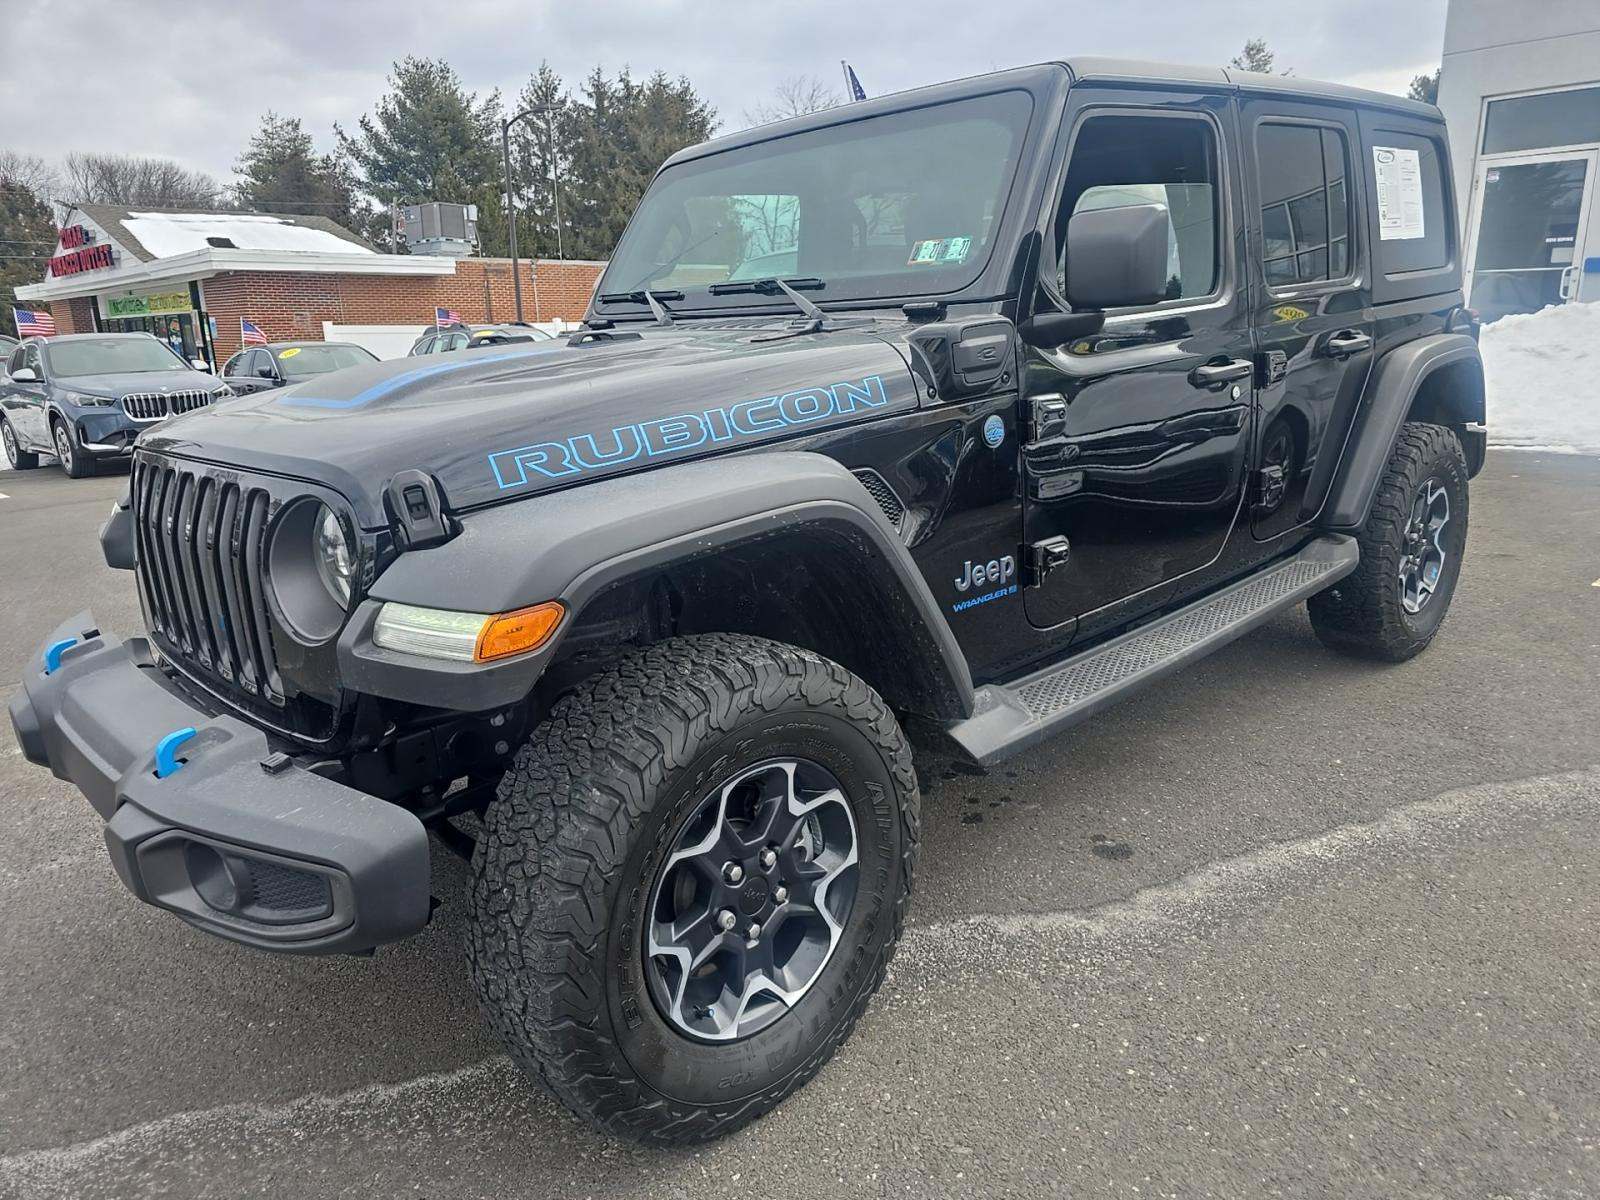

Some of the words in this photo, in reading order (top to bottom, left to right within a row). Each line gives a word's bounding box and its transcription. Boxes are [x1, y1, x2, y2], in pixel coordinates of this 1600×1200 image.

[487, 375, 888, 489] RUBICON
[954, 555, 1015, 592] Jeep
[952, 587, 1008, 613] WRANGLER
